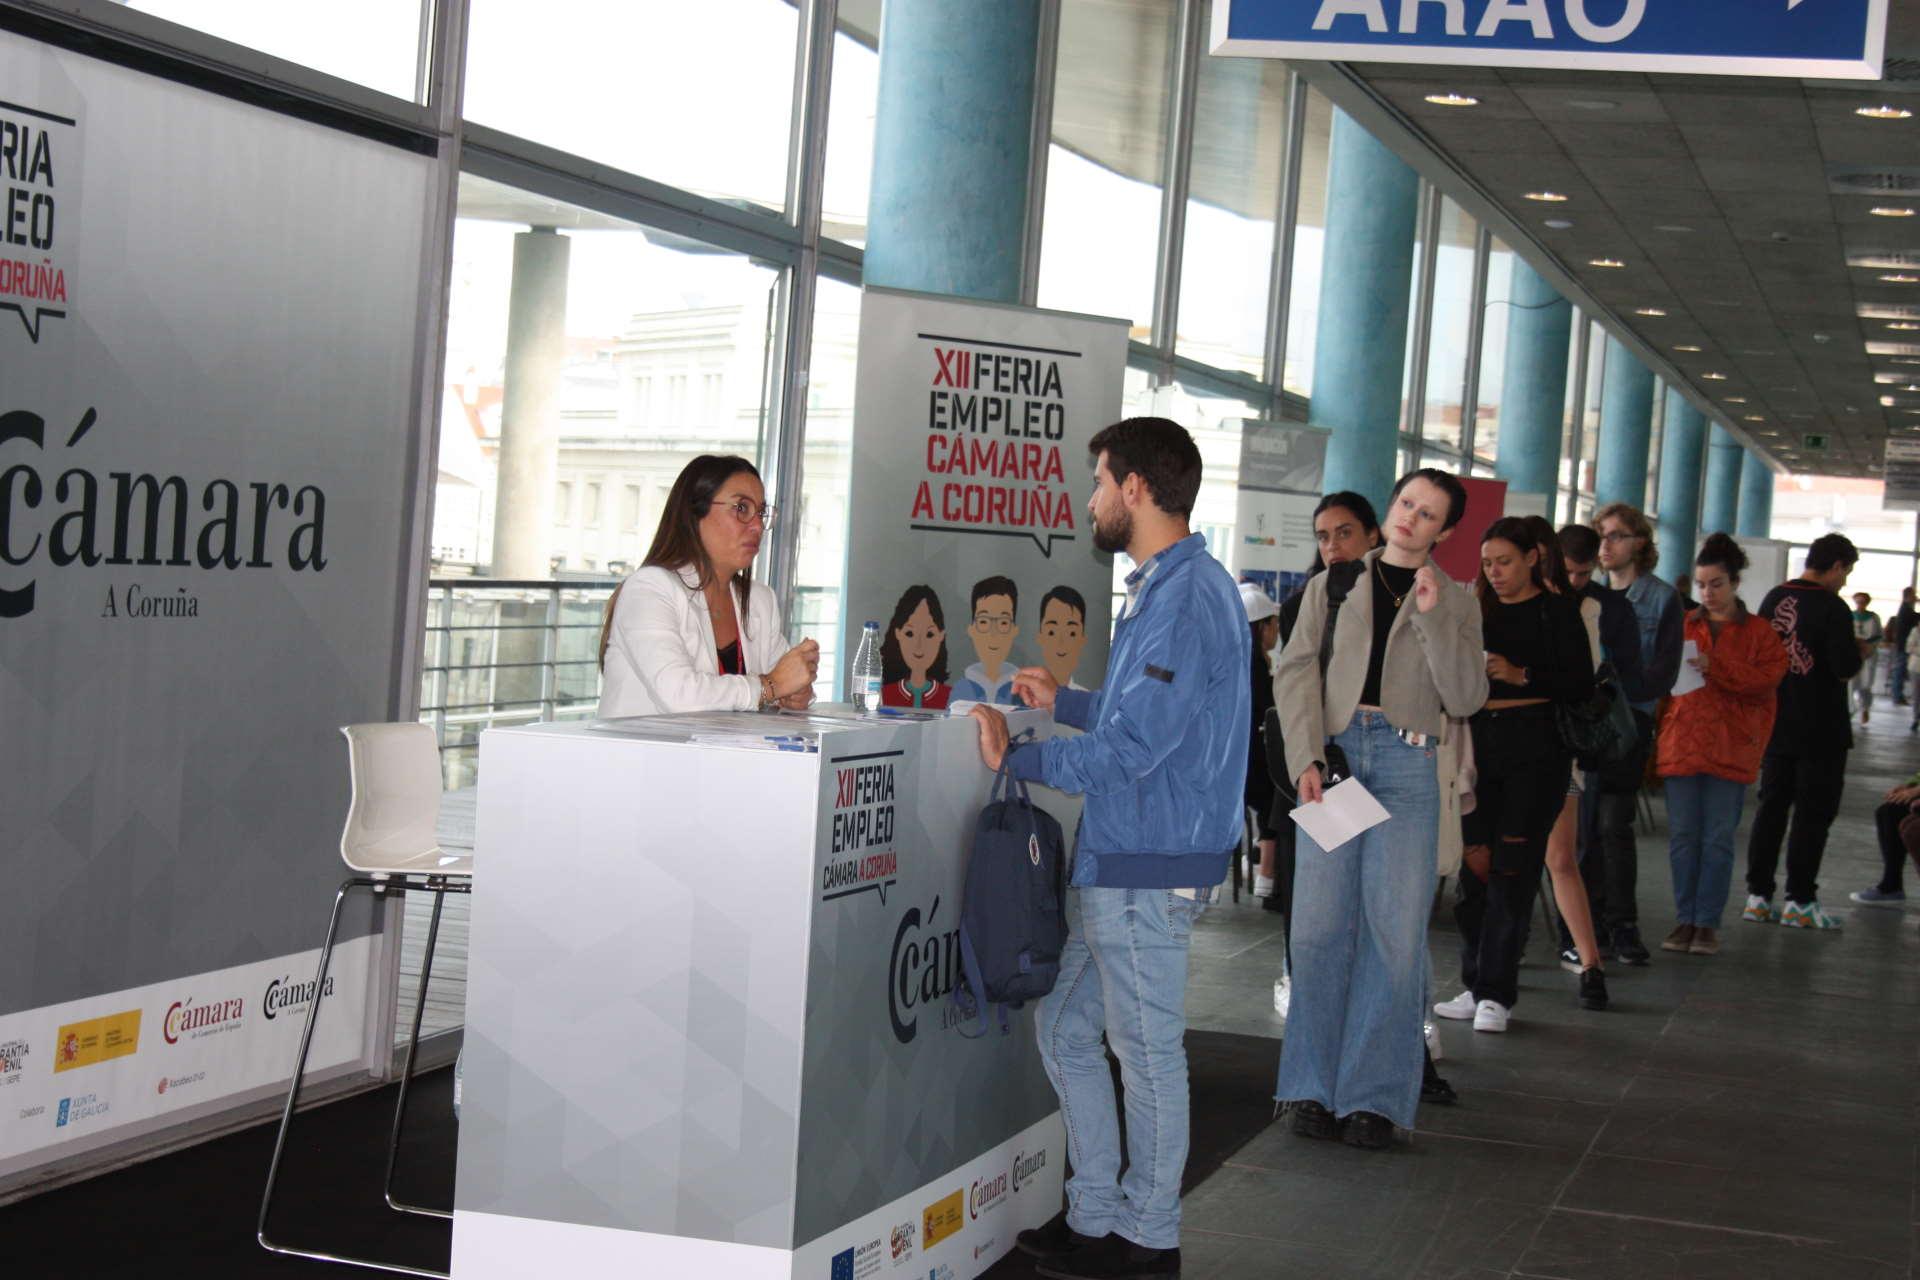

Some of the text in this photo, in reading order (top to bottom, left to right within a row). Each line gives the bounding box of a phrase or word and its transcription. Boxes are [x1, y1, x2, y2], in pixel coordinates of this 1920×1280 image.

[0, 187, 55, 251] EO
[973, 352, 1064, 399] FERIA
[929, 390, 1065, 441] EMPLEO
[927, 431, 1065, 484] CÁMARA
[911, 480, 1076, 529] A CORUÑA
[101, 583, 198, 618] A Coruña
[854, 763, 895, 806] FERIA
[831, 804, 894, 854] EMPLEO
[823, 859, 858, 890] CÁMARA
[865, 847, 897, 880] CORUÑA
